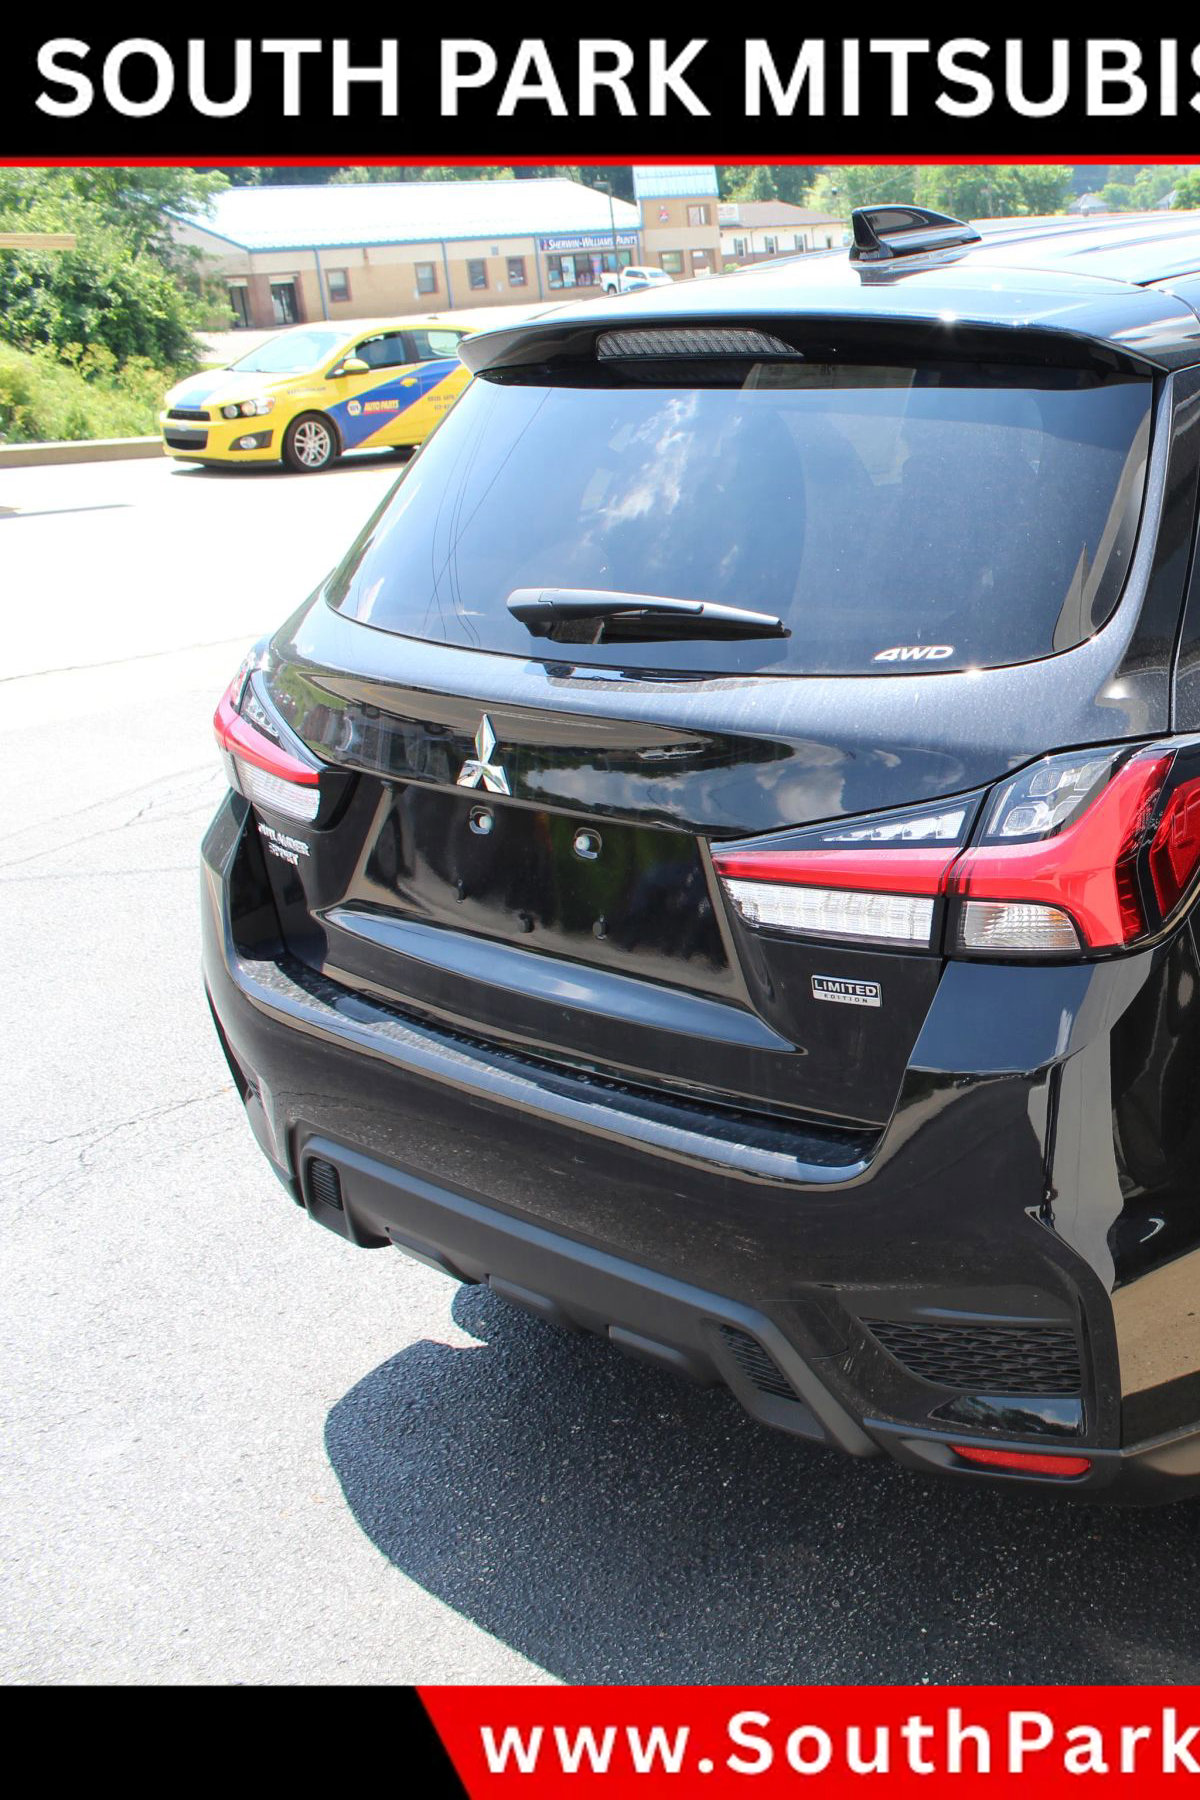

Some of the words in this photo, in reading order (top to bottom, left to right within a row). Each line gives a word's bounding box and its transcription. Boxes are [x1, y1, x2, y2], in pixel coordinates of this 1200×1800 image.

[874, 646, 954, 661] 4WD
[814, 979, 877, 996] LIMITED
[824, 993, 868, 1003] EDITION
